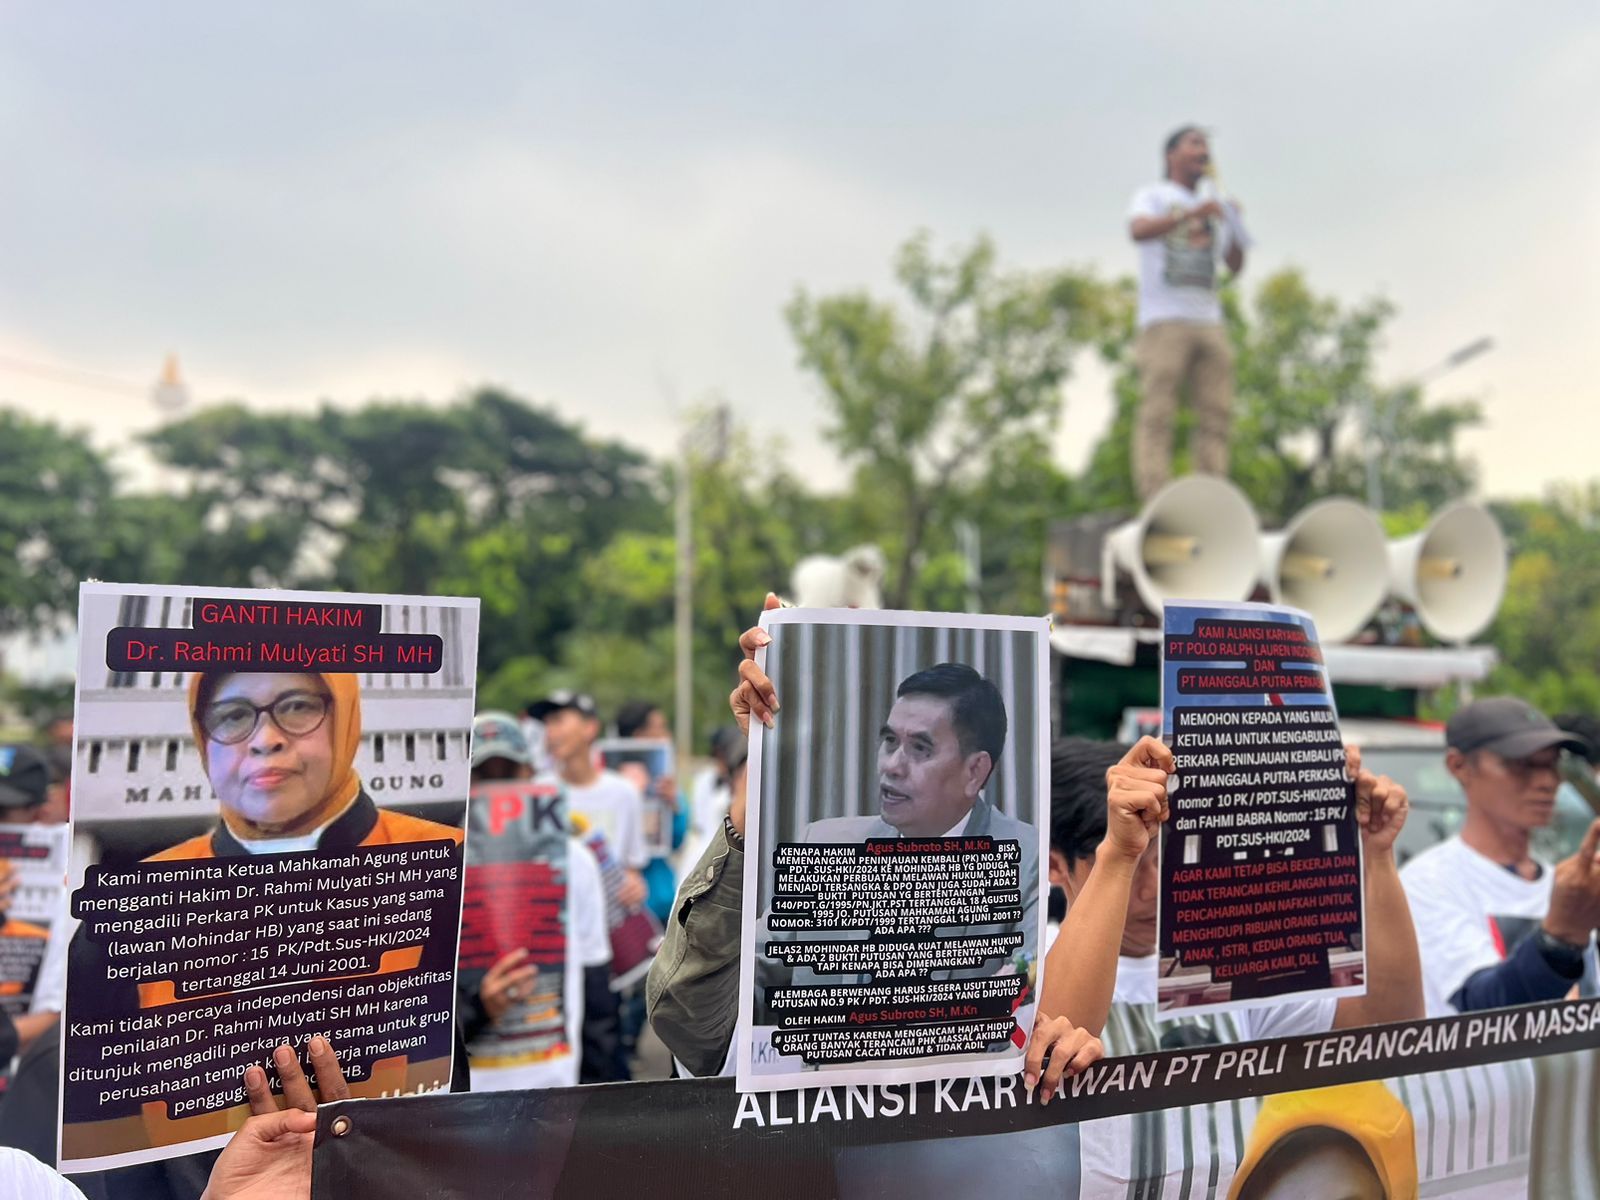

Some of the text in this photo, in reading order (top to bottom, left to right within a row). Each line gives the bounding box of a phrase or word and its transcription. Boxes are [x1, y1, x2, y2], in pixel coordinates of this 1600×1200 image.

[201, 604, 362, 626] GANTI HAKIM
[127, 641, 432, 667] Dr. Rahmi Mulyati SH MH
[1170, 642, 1184, 654] PT
[1187, 643, 1217, 654] POLO
[1220, 644, 1253, 655] RALPH
[1255, 645, 1290, 656] LAUREN
[1182, 675, 1292, 688] PT MANGGALA PUTRA
[1181, 711, 1309, 725] MEMOHON KEPADA YANG
[1178, 734, 1213, 746] KETUA
[1215, 733, 1232, 745] MA
[1235, 732, 1270, 744] UNTUK
[1183, 769, 1340, 788] PT MANGGALA PUTRA PERKASA
[1178, 797, 1212, 809] nomor
[1218, 795, 1231, 807] 10
[1234, 794, 1248, 806] PK
[1257, 788, 1346, 805] PDT.SUS-HKI/2024
[781, 848, 820, 856] KENAPA
[823, 848, 855, 856] HAKIM
[866, 842, 894, 855] Agus
[897, 841, 941, 852] Subroto
[965, 840, 990, 850] M.Kn
[998, 844, 1016, 852] BISA
[1217, 829, 1311, 848] PDT.SUS-HKI/2024
[98, 846, 450, 886] Kami meminta Ketua Mahkamah Agung untuk
[777, 857, 855, 865] MEMENANGKAN
[859, 856, 918, 865] PENINJAUAN
[921, 855, 960, 863] KEMBALI
[962, 854, 979, 863] (PK)
[981, 853, 1001, 861] NO.9
[790, 866, 811, 874] PDT.
[881, 865, 891, 873] KE
[895, 864, 946, 872] MOHINDAR
[963, 863, 974, 871] YG
[977, 861, 1009, 870] DIDUGA
[1173, 856, 1356, 883] AGAR KAMI TETAP BISA BEKERJA DAN
[843, 873, 899, 882] PERBUATAN
[903, 872, 949, 881] MELAWAN
[952, 871, 986, 880] HUKUM,
[989, 869, 1016, 878] SUDAH
[79, 867, 457, 912] mengganti Hakim Dr. Rahmi Mulyati SH MH yang
[1173, 874, 1357, 903] TIDAK TERANCAM KEHILANGAN MATA
[94, 888, 444, 934] mengadili Perkara PK untuk Kasus yang sama
[775, 894, 1018, 910] 140/PDT.G/1995/PN.JKT.PST TERTANGGAL 18 AGUSTUS
[1177, 893, 1353, 922] PENCAHARIAN DAN NAFKAH UNTUK
[771, 919, 814, 927] NOMOR:
[817, 919, 837, 927] 3101
[841, 917, 896, 927] K/PDT/1999
[898, 916, 957, 925] TERTANGGAL
[960, 914, 969, 923] 14
[971, 913, 990, 924] JUNI
[993, 912, 1010, 920] 2001
[1173, 912, 1357, 943] MENGHIDUPI RIBUAN ORANG MAKAN
[108, 908, 432, 957] (lawan Mohindar HB) yang saat ini sedang
[107, 961, 178, 980] berjalan
[184, 953, 238, 970] nomor
[251, 946, 269, 961] 15
[278, 927, 430, 956] PK/Pdt.Sus-HKI/2024
[182, 956, 371, 992] tertanggal 14 Juni 2001.
[71, 971, 452, 1036] Kami tidak percaya independensi dan objektifitas
[785, 1016, 810, 1025] OLEH
[813, 1015, 846, 1024] HAKIM
[849, 1011, 878, 1023] Agus
[880, 1009, 926, 1020] Subroto
[950, 1005, 977, 1016] M.Kn
[807, 1041, 985, 1059] PUTUSAN CACAT HUKUM & TIDAK ADIL
[733, 1083, 917, 1128] ALIANSI
[1165, 1055, 1209, 1086] PT
[1215, 1044, 1288, 1080] PRLI
[1303, 1022, 1459, 1069] TERANCAM
[1466, 1014, 1519, 1048] PHK
